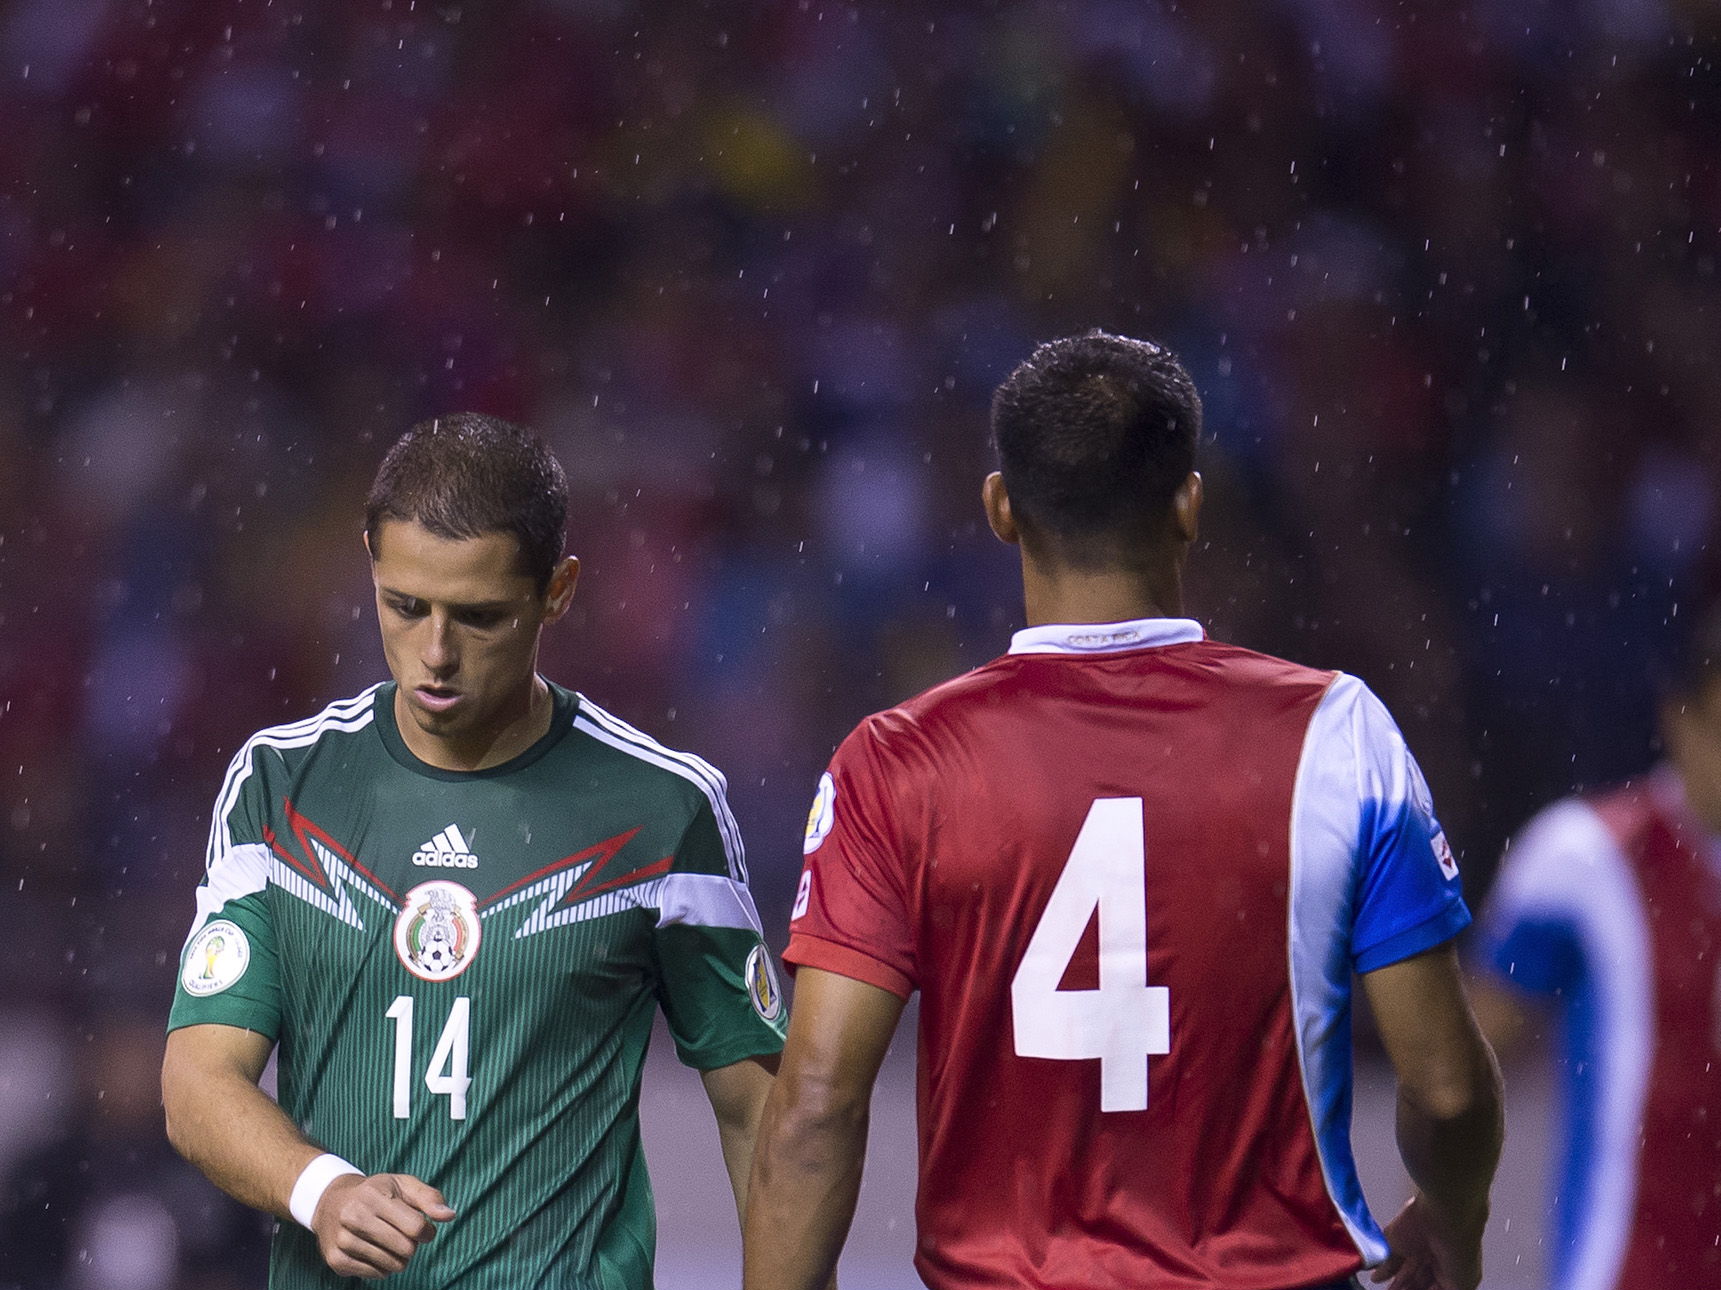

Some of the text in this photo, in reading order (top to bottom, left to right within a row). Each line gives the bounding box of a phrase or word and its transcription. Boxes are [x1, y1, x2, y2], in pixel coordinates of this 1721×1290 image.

[412, 849, 479, 869] adidas
[1011, 797, 1171, 1112] 4
[385, 995, 473, 1120] 14
